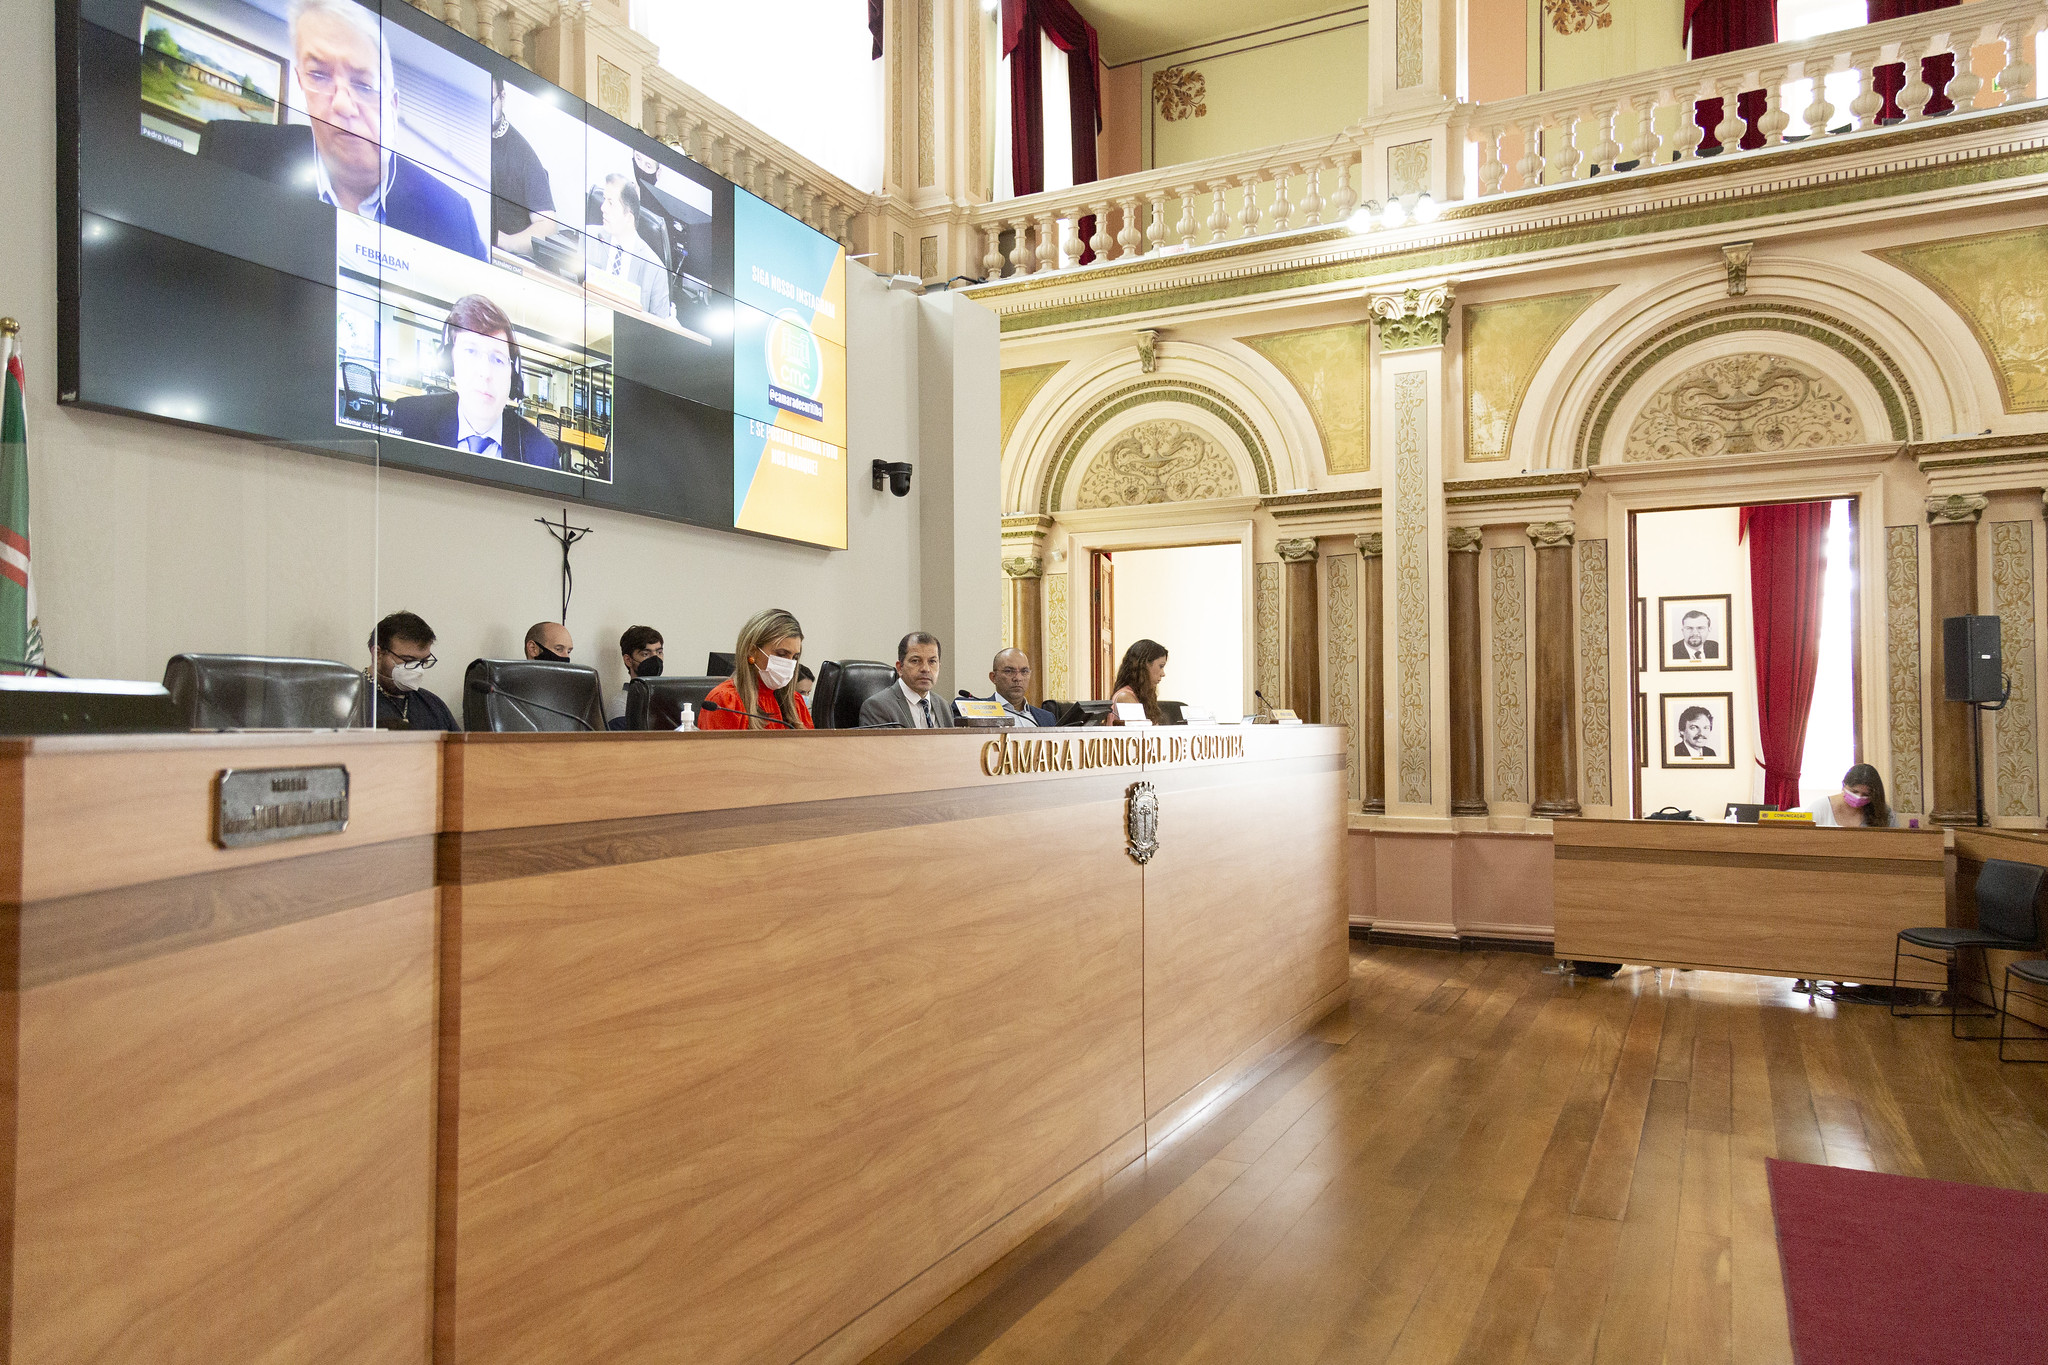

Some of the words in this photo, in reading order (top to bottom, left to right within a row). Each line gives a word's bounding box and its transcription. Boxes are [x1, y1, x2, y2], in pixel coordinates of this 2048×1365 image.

[143, 128, 162, 140] Pedro
[355, 243, 410, 271] FEBRABAN
[752, 265, 770, 288] SIGA
[771, 274, 795, 300] NOSSO
[981, 732, 1075, 777] CÂMARA
[1077, 736, 1168, 770] MUNICIPAL
[1169, 735, 1188, 764] DE
[1190, 733, 1245, 762] CURITIBA
